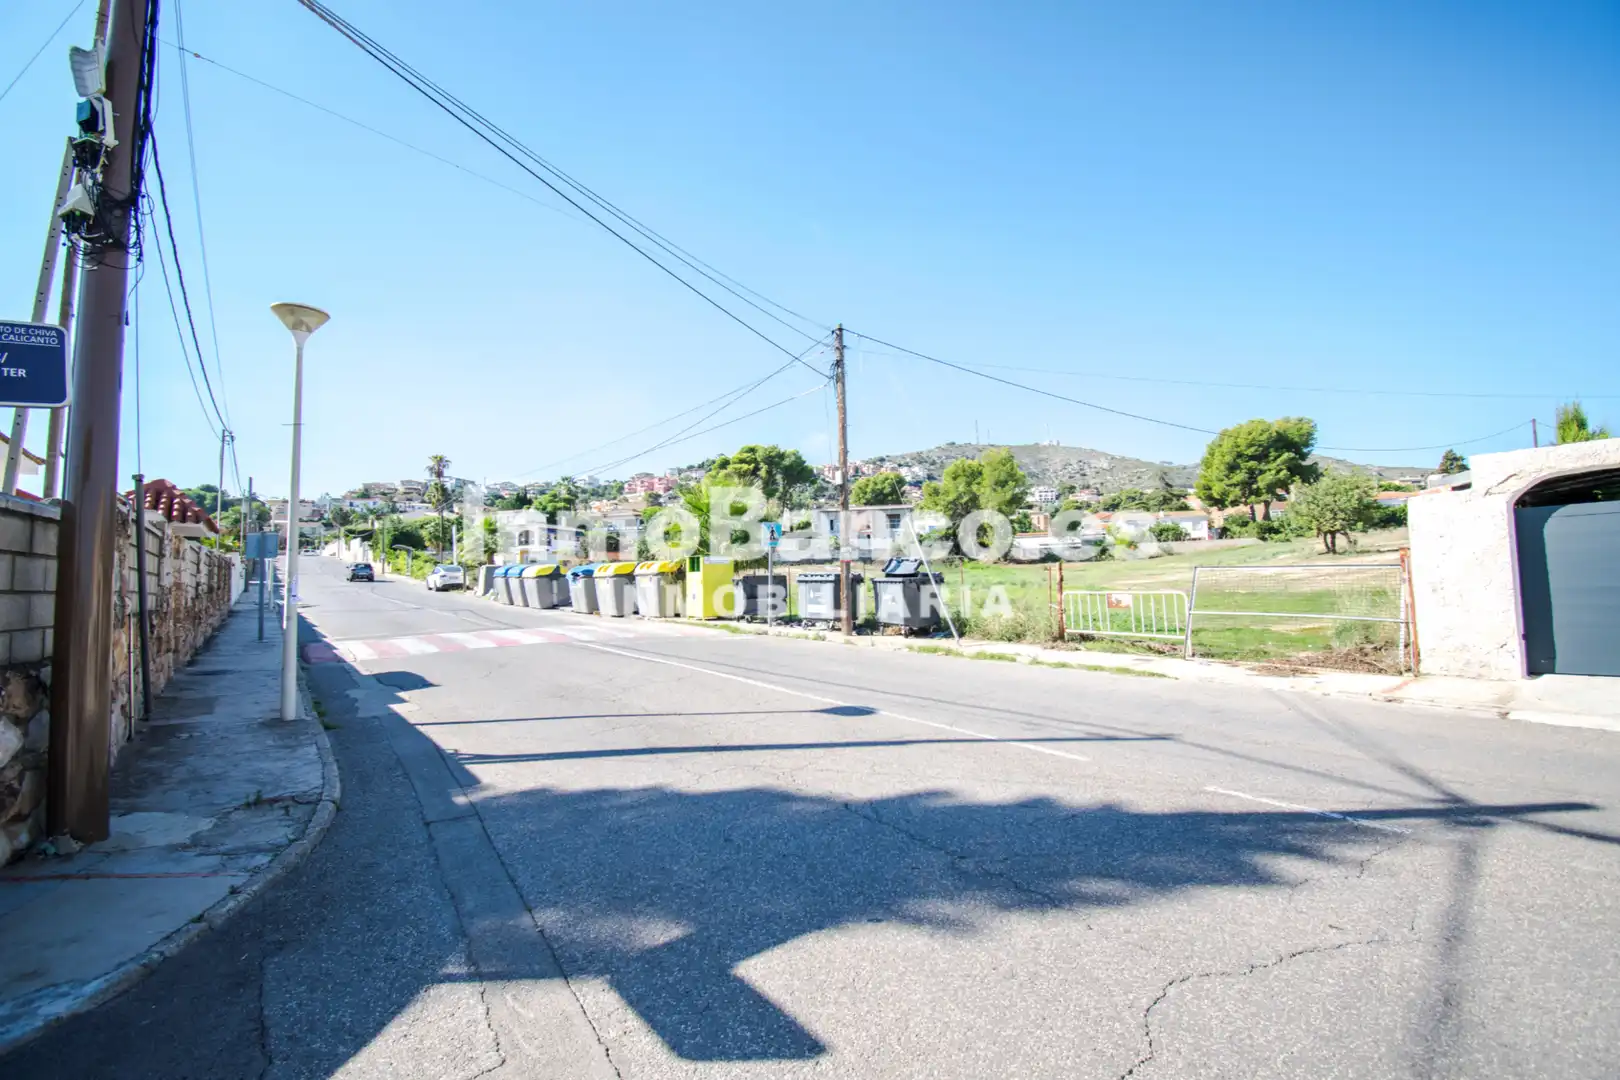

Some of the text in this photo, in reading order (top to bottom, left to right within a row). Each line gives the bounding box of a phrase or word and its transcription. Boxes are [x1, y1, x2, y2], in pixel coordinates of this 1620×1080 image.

[14, 327, 27, 335] DE
[28, 328, 58, 337] CHIVA
[1, 333, 59, 345] CALICANTO
[1, 367, 28, 378] TER
